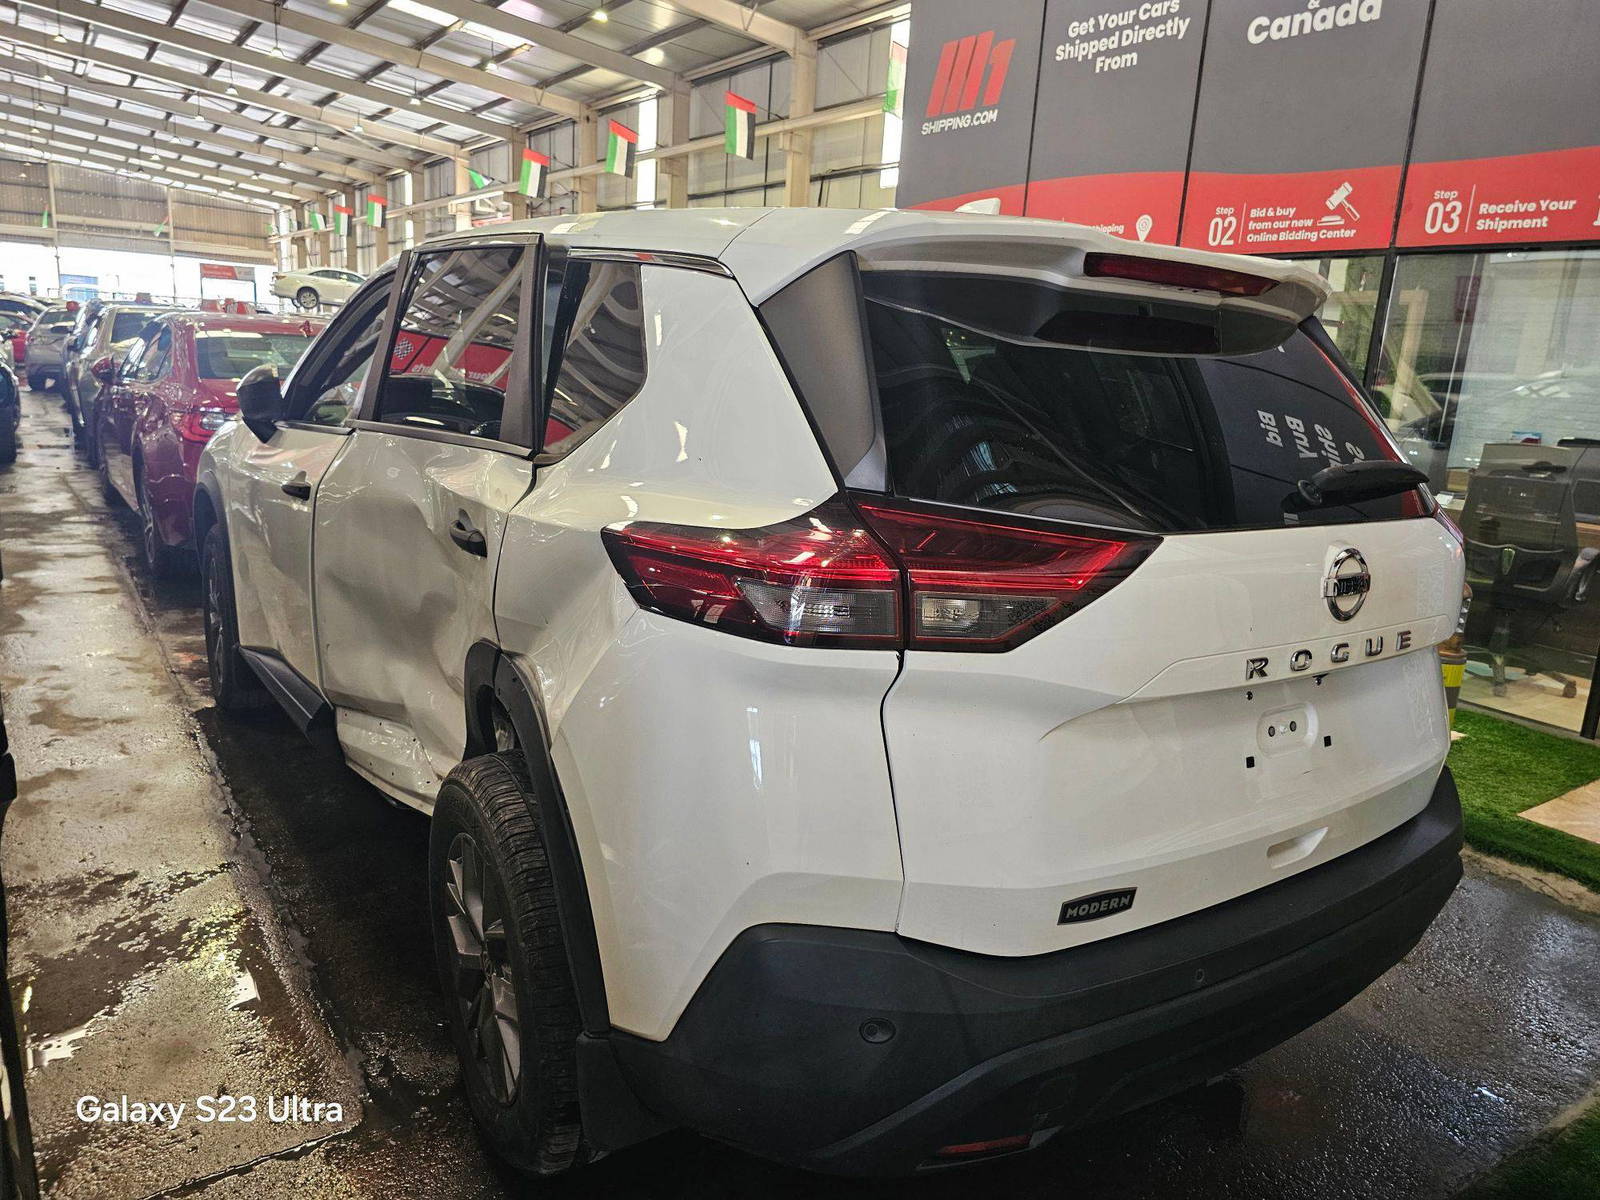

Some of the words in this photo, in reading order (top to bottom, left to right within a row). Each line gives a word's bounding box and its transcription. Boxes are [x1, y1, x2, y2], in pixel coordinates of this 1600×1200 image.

[1068, 17, 1095, 38] Get
[1098, 9, 1137, 31] Your
[1139, 0, 1180, 20] Cars
[1247, 0, 1382, 44] Canada
[1055, 31, 1119, 61] Shipped
[1121, 17, 1191, 40] Directly
[1095, 52, 1138, 73] From
[921, 109, 998, 135] SHIPPING.COM
[1434, 190, 1458, 200] Step
[1216, 206, 1235, 216] Step
[1249, 207, 1266, 218] Bid
[1267, 207, 1275, 217] &
[1276, 206, 1296, 218] buy
[1424, 200, 1463, 234] 03
[1479, 200, 1536, 215] Receive
[1539, 199, 1577, 211] Your
[1208, 216, 1237, 246] 02
[1247, 232, 1278, 243] Online
[1279, 230, 1318, 242] Bidding
[1319, 227, 1356, 239] Center
[1248, 220, 1272, 230] from
[1272, 220, 1290, 229] our
[1291, 218, 1313, 228] new
[1476, 216, 1548, 232] Shipment
[1246, 630, 1411, 681] ROGUE
[1065, 895, 1131, 918] MODERN
